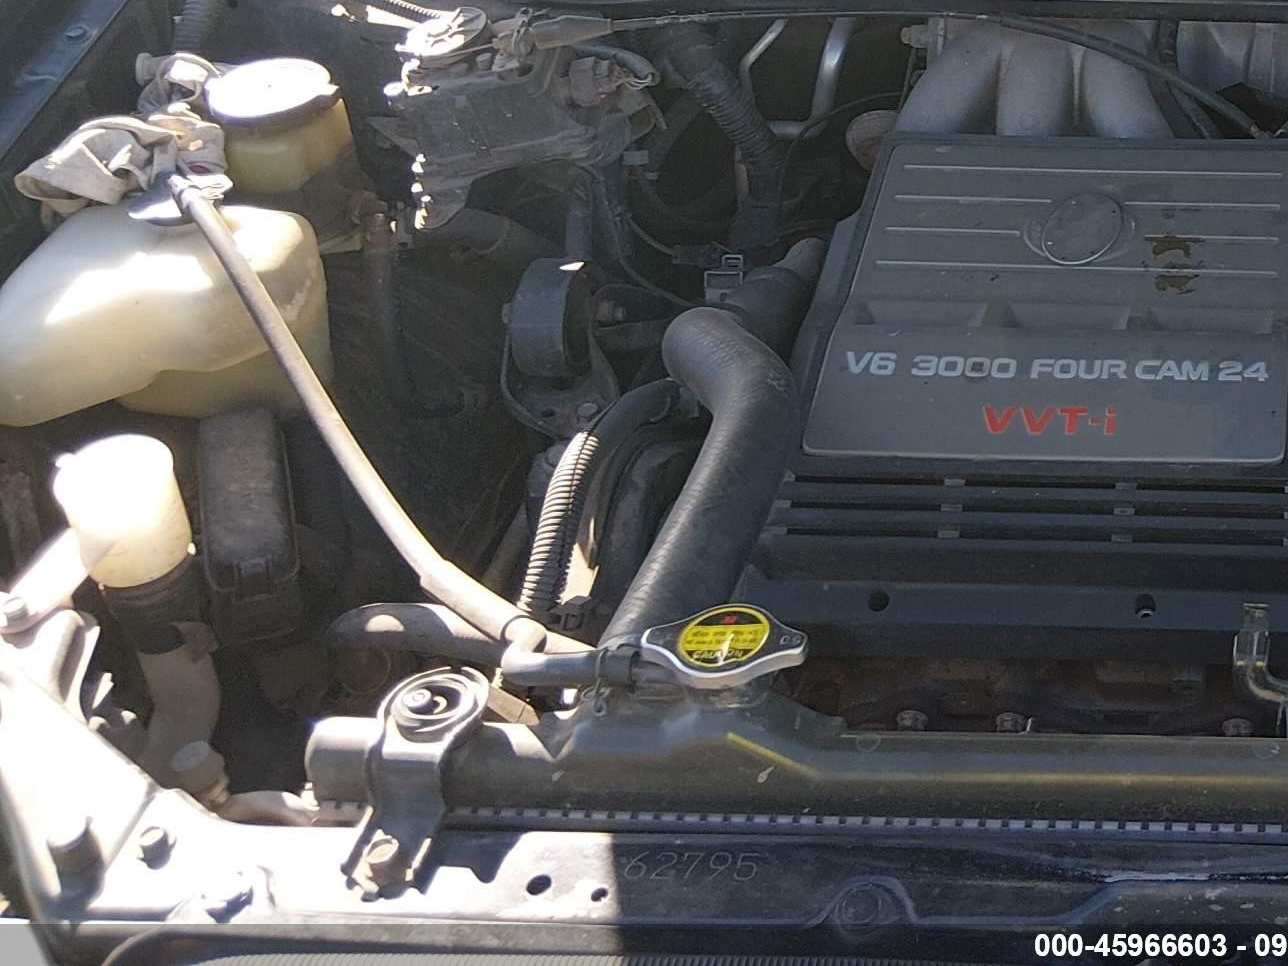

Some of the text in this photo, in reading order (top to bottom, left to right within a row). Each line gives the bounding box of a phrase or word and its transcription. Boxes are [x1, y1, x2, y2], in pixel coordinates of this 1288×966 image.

[845, 351, 1269, 382] V6 3000 FOUR CAM 24
[982, 404, 1117, 435] VVT-i
[691, 649, 744, 660] CAUON
[623, 851, 761, 882] 62795
